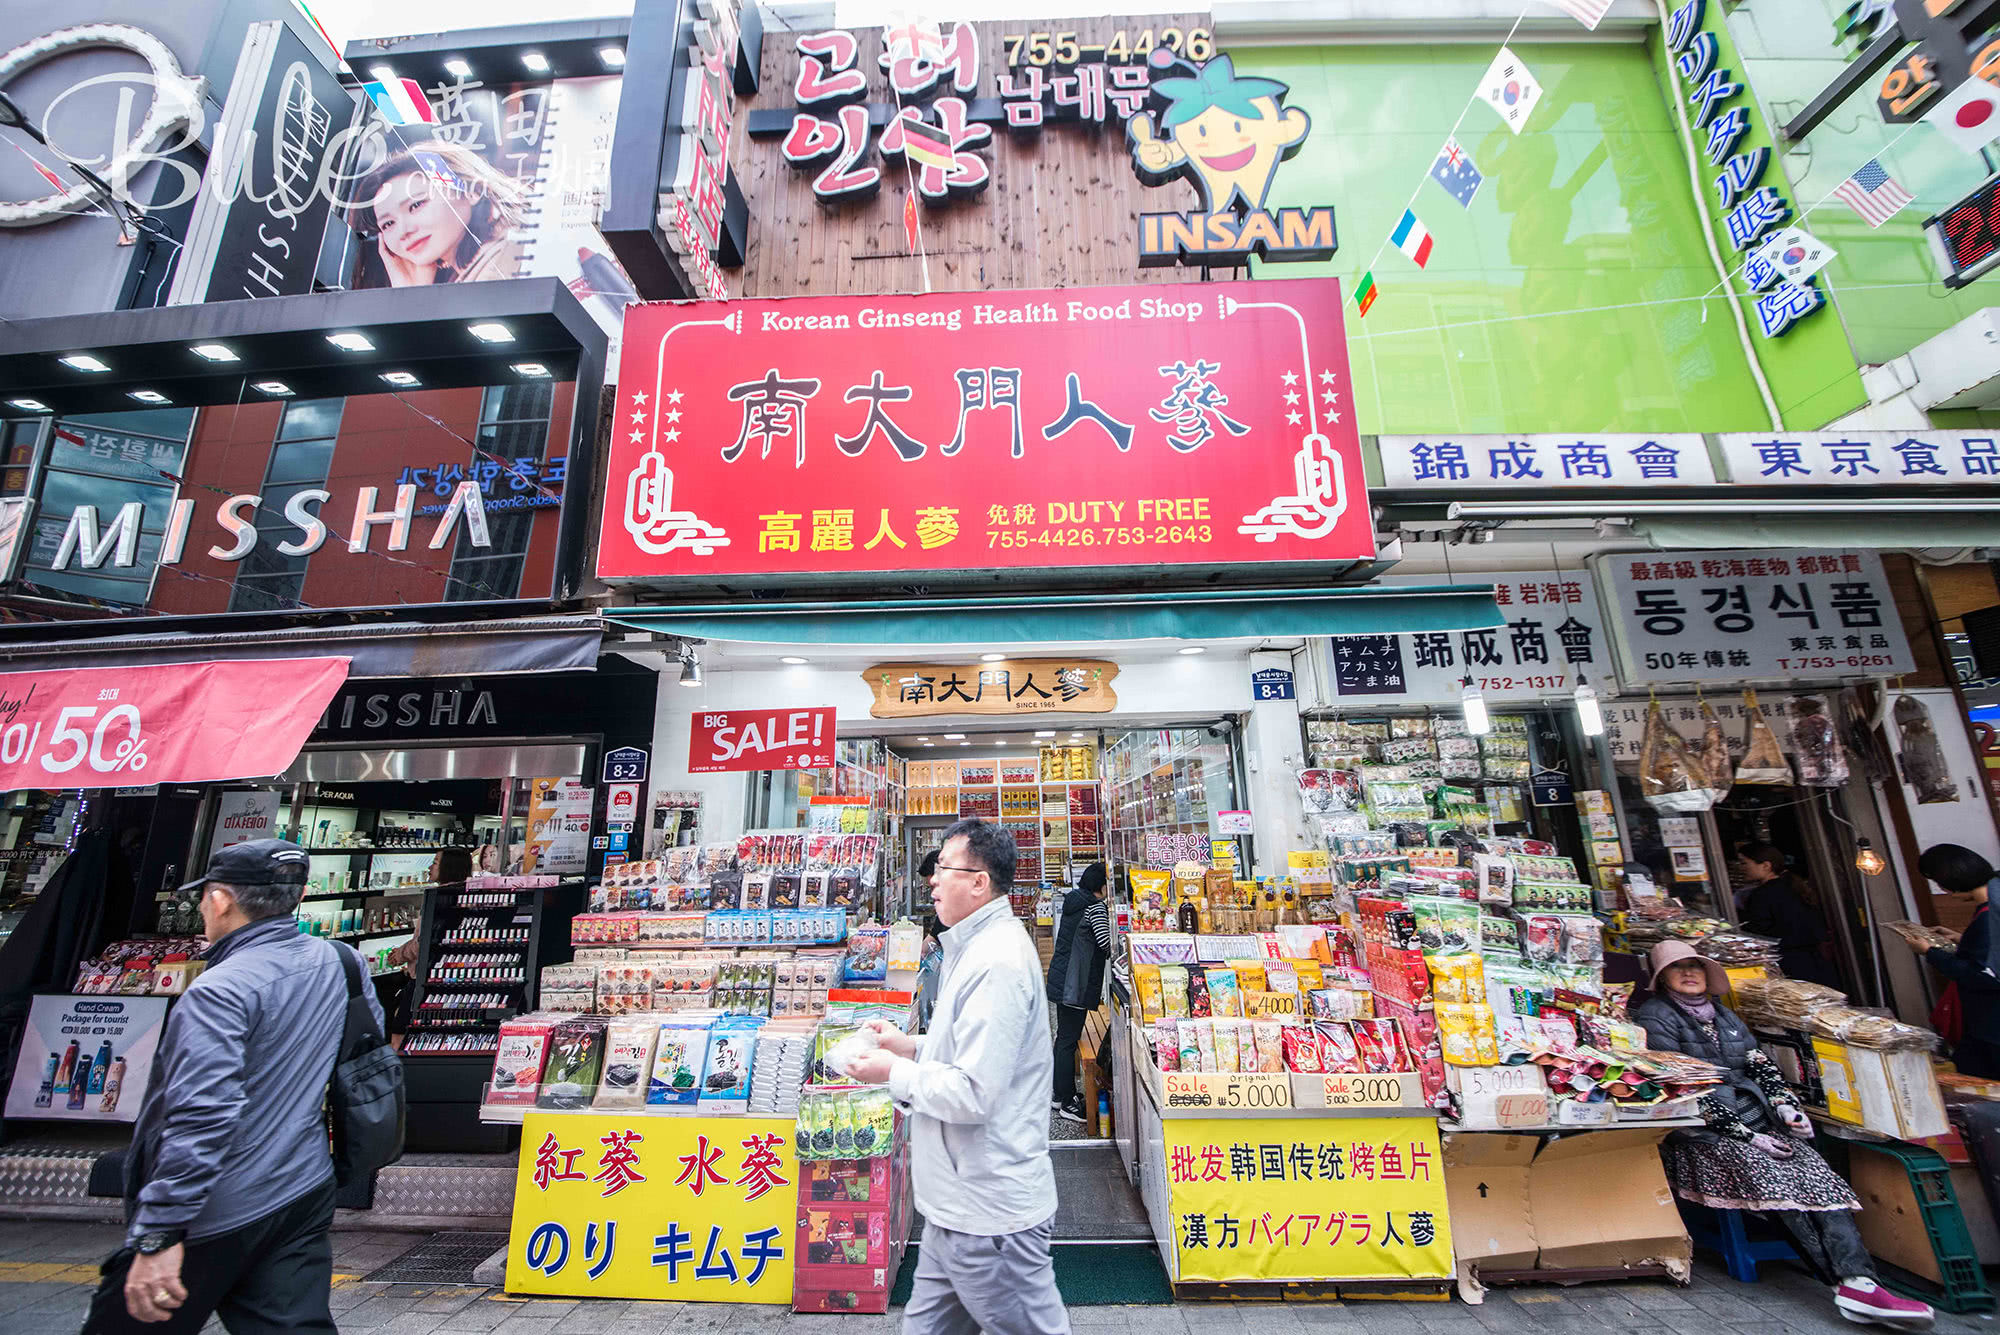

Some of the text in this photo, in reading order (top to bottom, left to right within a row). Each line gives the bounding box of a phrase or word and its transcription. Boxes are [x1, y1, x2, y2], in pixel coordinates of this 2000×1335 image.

[1003, 27, 1212, 68] 755-4426
[996, 65, 1153, 127] 남대문
[1142, 208, 1337, 255] INSAM
[761, 299, 1204, 333] Korean Ginseng Health Food Shop
[720, 358, 1252, 470] 南大門人蔘
[1411, 440, 1680, 482] 錦成商會
[1752, 438, 2000, 477] 東京食品
[987, 498, 1211, 526] 免稅 DUTY FREE
[51, 481, 493, 571] MISSHA
[758, 507, 960, 554] 高麗人蔘
[987, 525, 1213, 549] 755-4426.753-2643
[1634, 582, 1883, 636] 동경식품
[1338, 644, 1395, 656] キムチ
[1413, 617, 1594, 668] 錦成商會
[1787, 634, 1889, 652] 東京食品
[1340, 661, 1398, 673] アカミソ
[1645, 651, 1699, 670] 50年
[1777, 654, 1894, 670] T.753-6261
[1262, 684, 1285, 698] 8-1
[1342, 675, 1400, 687] ごま油
[1480, 676, 1565, 690] 752-1317
[97, 688, 120, 701] 최대
[317, 691, 497, 729] ISSHA
[703, 714, 728, 728] BIG
[40, 704, 148, 774] 50%
[711, 711, 824, 762] SALE!
[613, 764, 637, 777] 8-2
[1548, 788, 1559, 801] 8
[1147, 834, 1209, 849] 日本語OK
[1147, 849, 1210, 863] 中国語OK
[61, 1014, 129, 1023] Package for tourist
[78, 1003, 120, 1011] Hand Cream
[1167, 1075, 1208, 1093] Sale
[1325, 1078, 1350, 1094] Sale
[533, 1129, 790, 1201] 紅蔘 水蔘
[1171, 1142, 1433, 1182] 批发韩国传统烤鱼片
[1182, 1210, 1435, 1250] 漢方バイアグラ人蔘
[526, 1220, 784, 1287] のり キムチ
